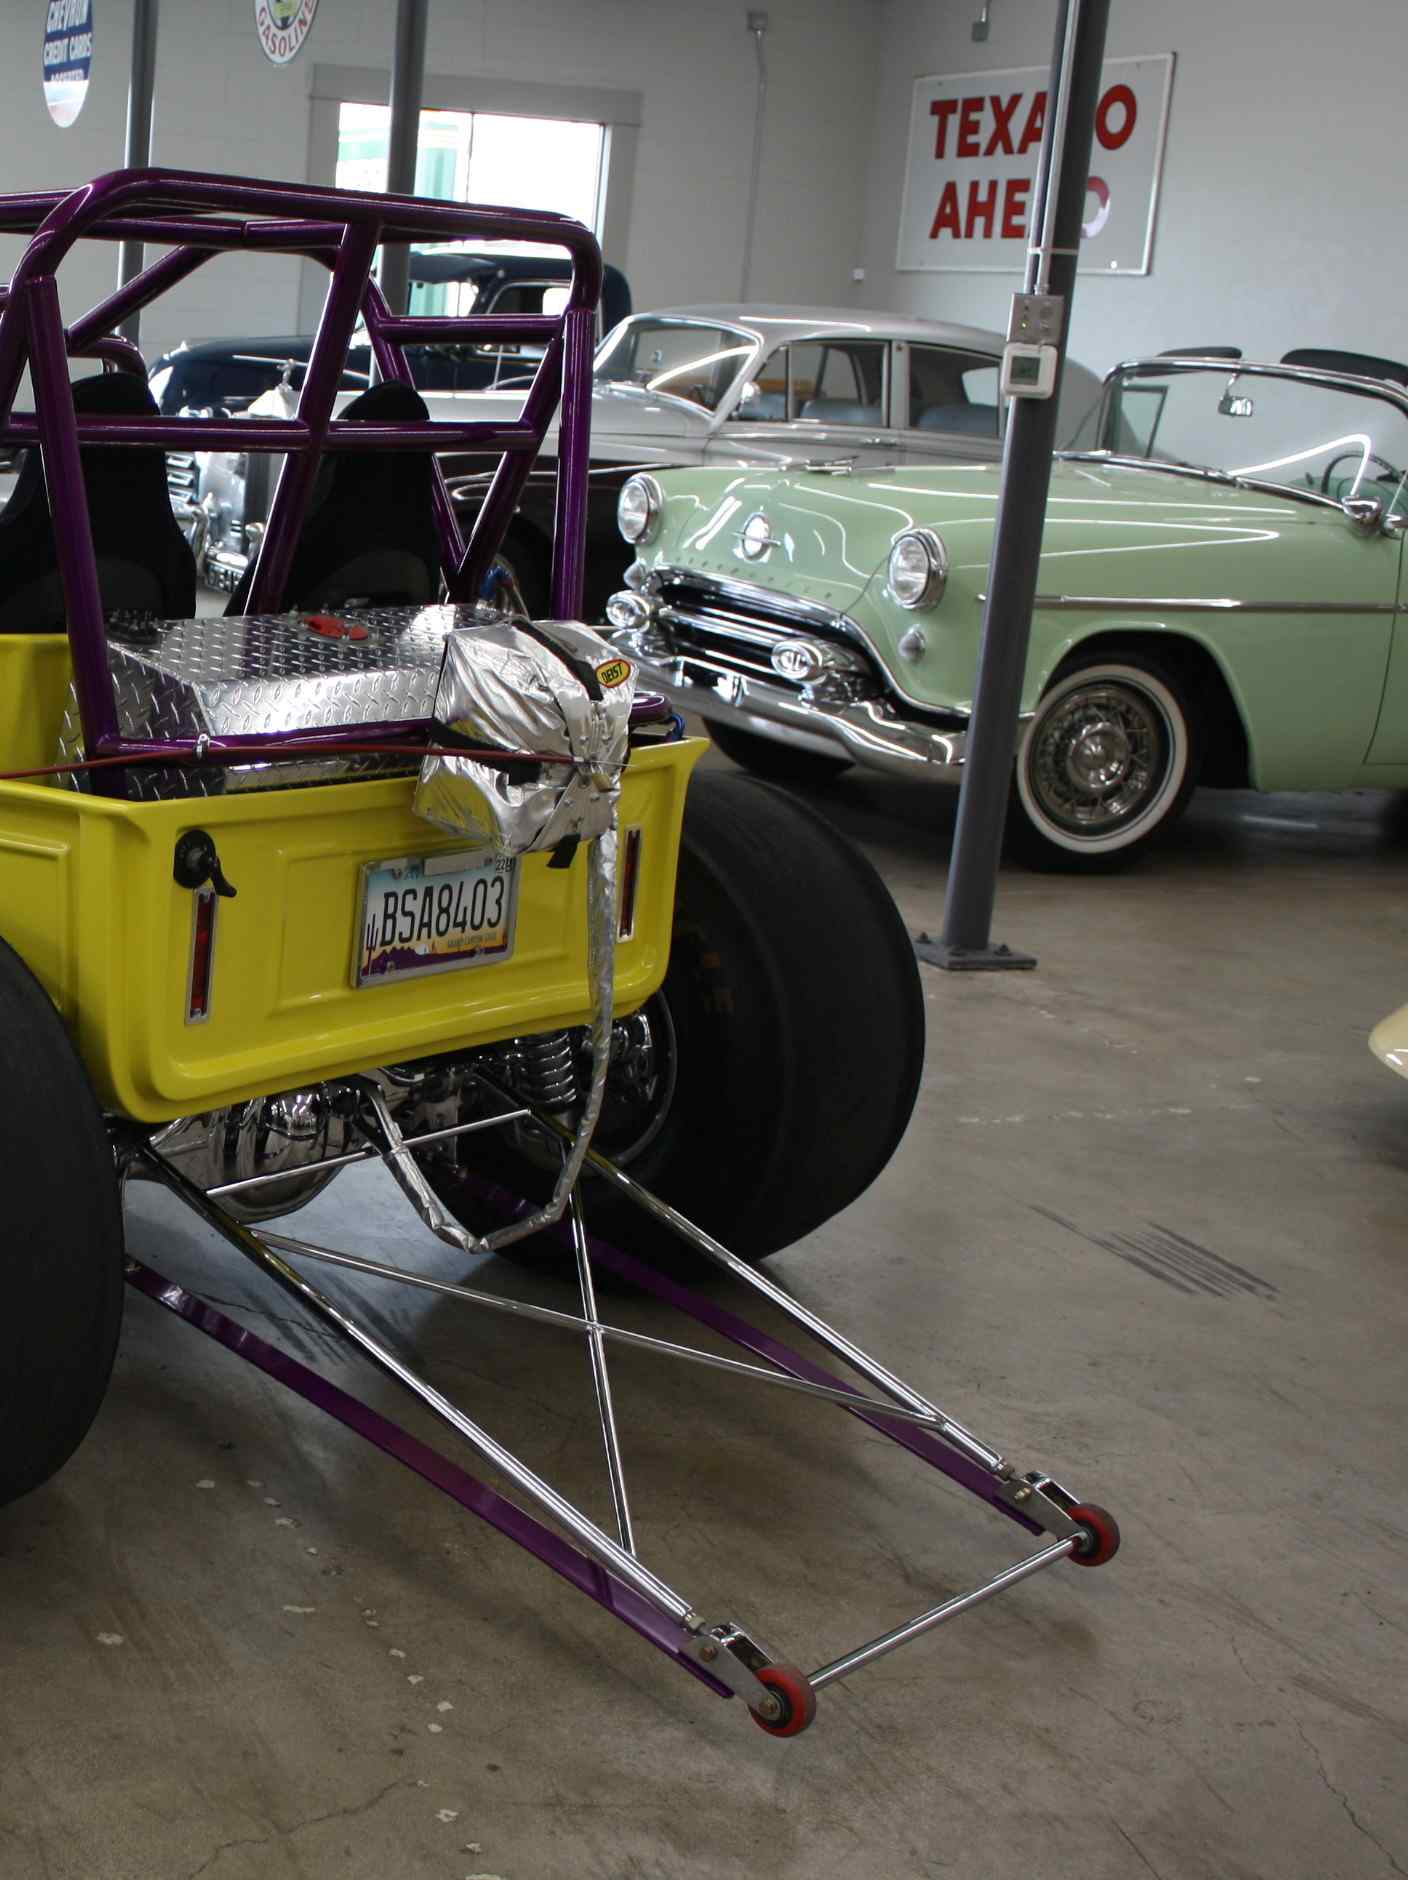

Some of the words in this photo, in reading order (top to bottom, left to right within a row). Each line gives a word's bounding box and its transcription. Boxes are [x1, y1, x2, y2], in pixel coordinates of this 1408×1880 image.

[47, 0, 89, 33] CHEVRON
[44, 38, 69, 65] CREDIT
[69, 32, 92, 61] CARDS
[929, 84, 1138, 160] TEXAO
[929, 175, 1111, 240] AHED
[601, 663, 623, 683] DEIST
[380, 876, 505, 947] BSA8403
